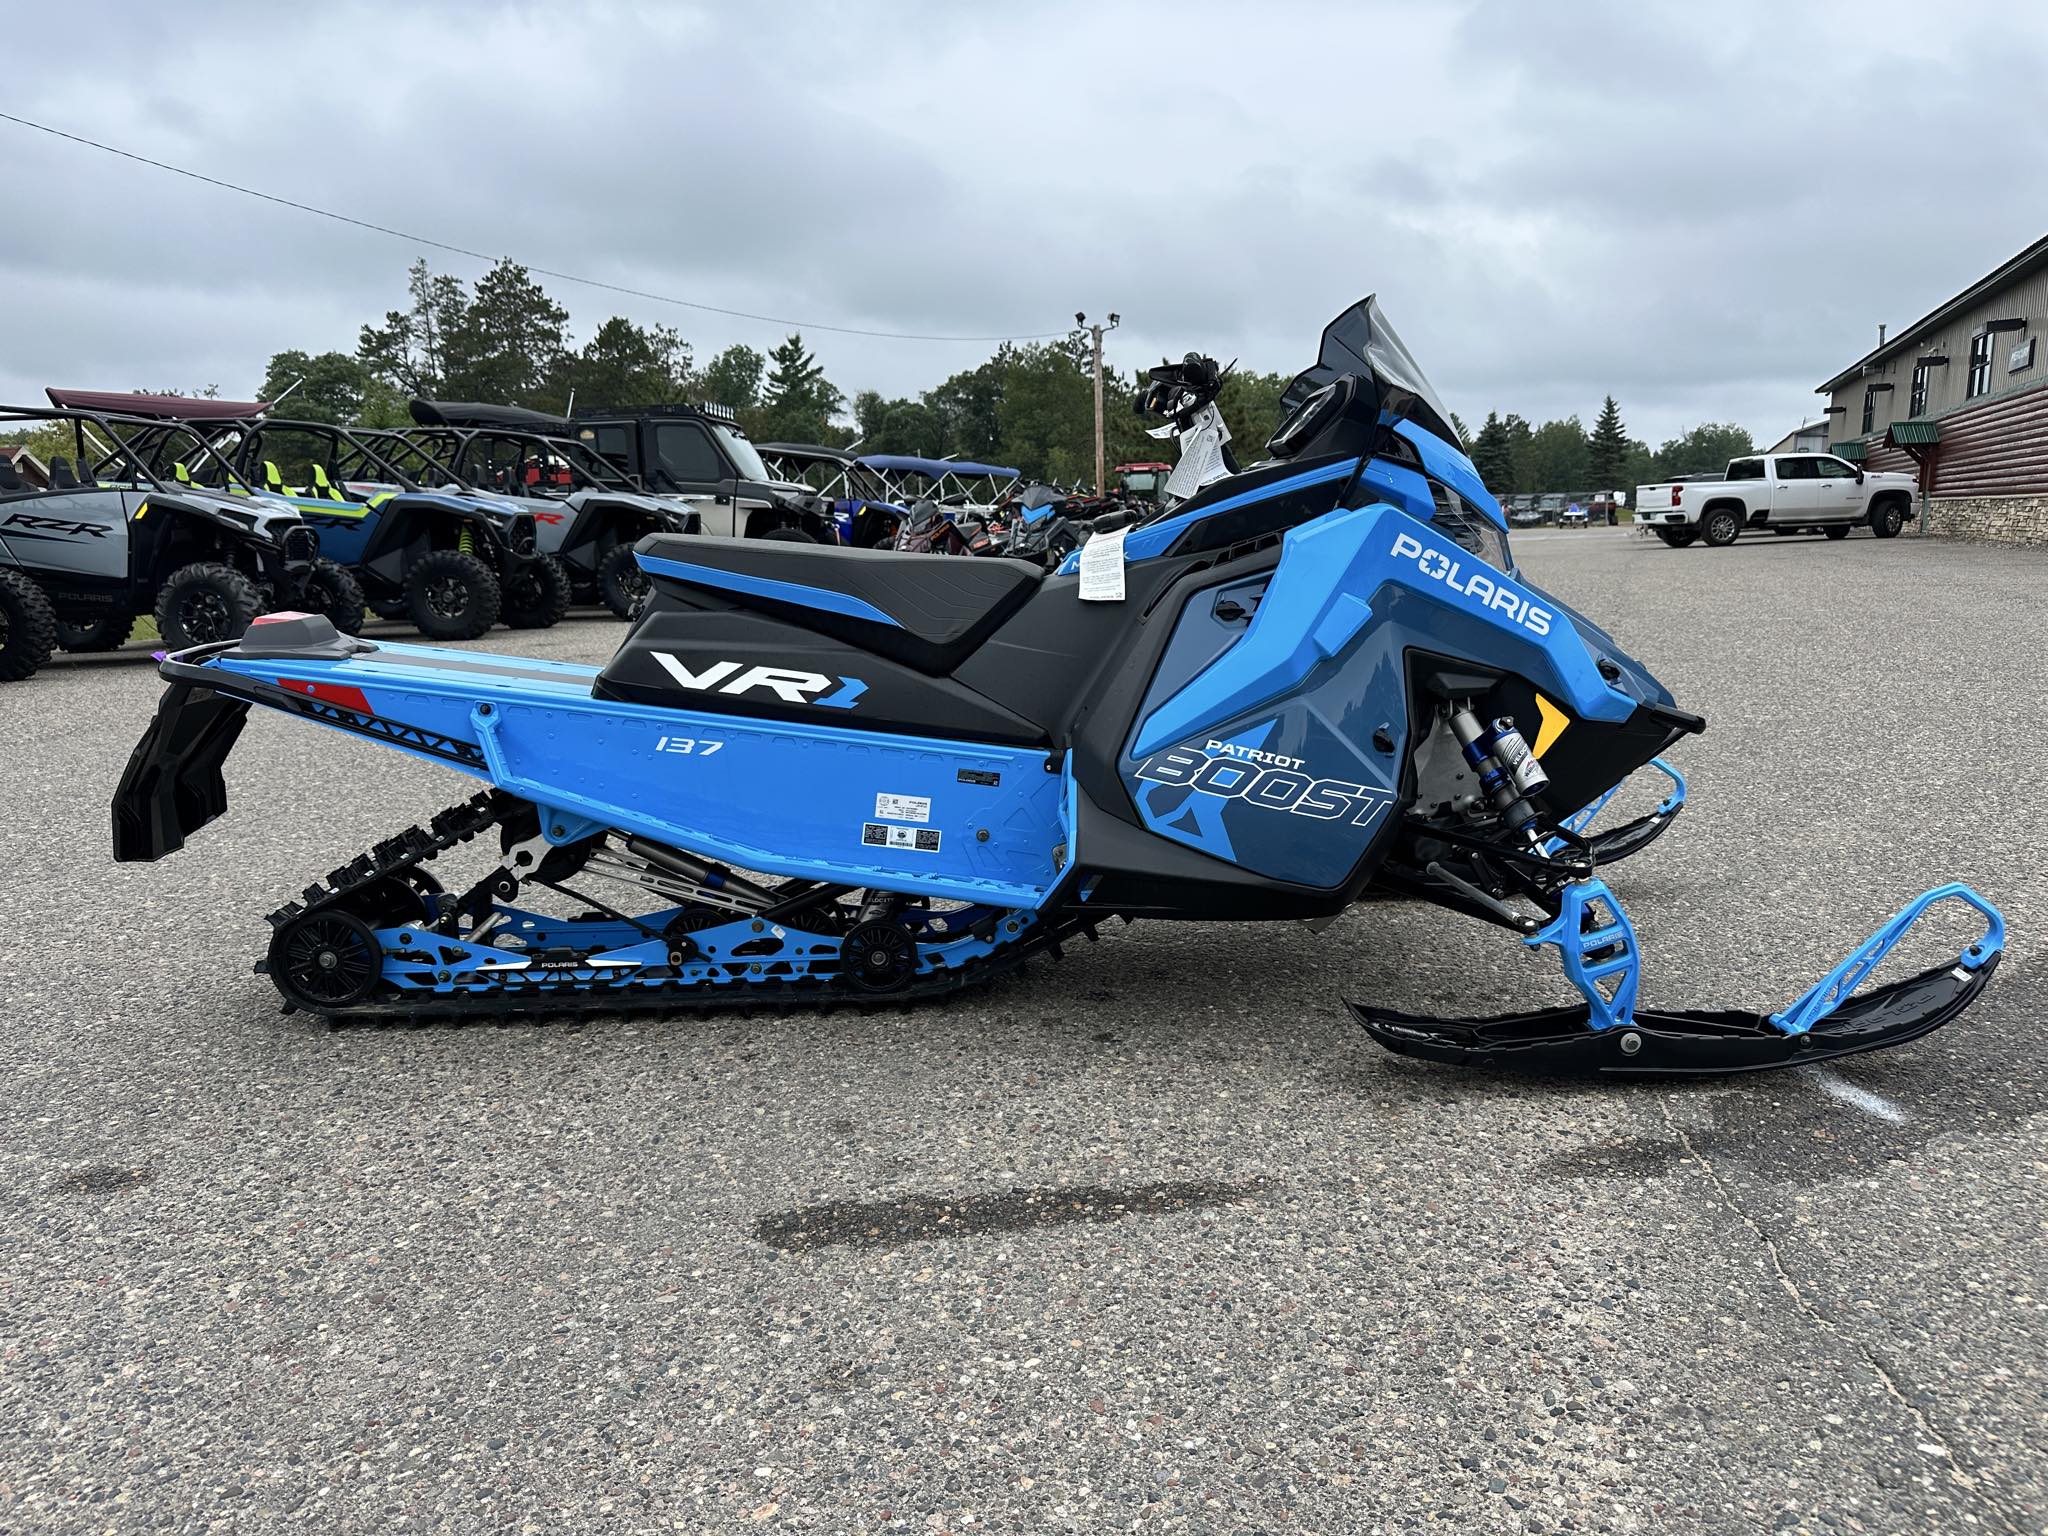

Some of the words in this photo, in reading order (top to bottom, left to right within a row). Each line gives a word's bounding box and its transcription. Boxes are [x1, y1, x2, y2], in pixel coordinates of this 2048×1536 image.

[1, 513, 114, 538] RZR
[58, 592, 113, 603] POLARIS
[1390, 533, 1552, 636] POLARIS
[650, 651, 869, 709] VR1
[655, 736, 724, 756] 137
[1205, 739, 1306, 770] PATRIOT
[1134, 746, 1393, 827] BOOST
